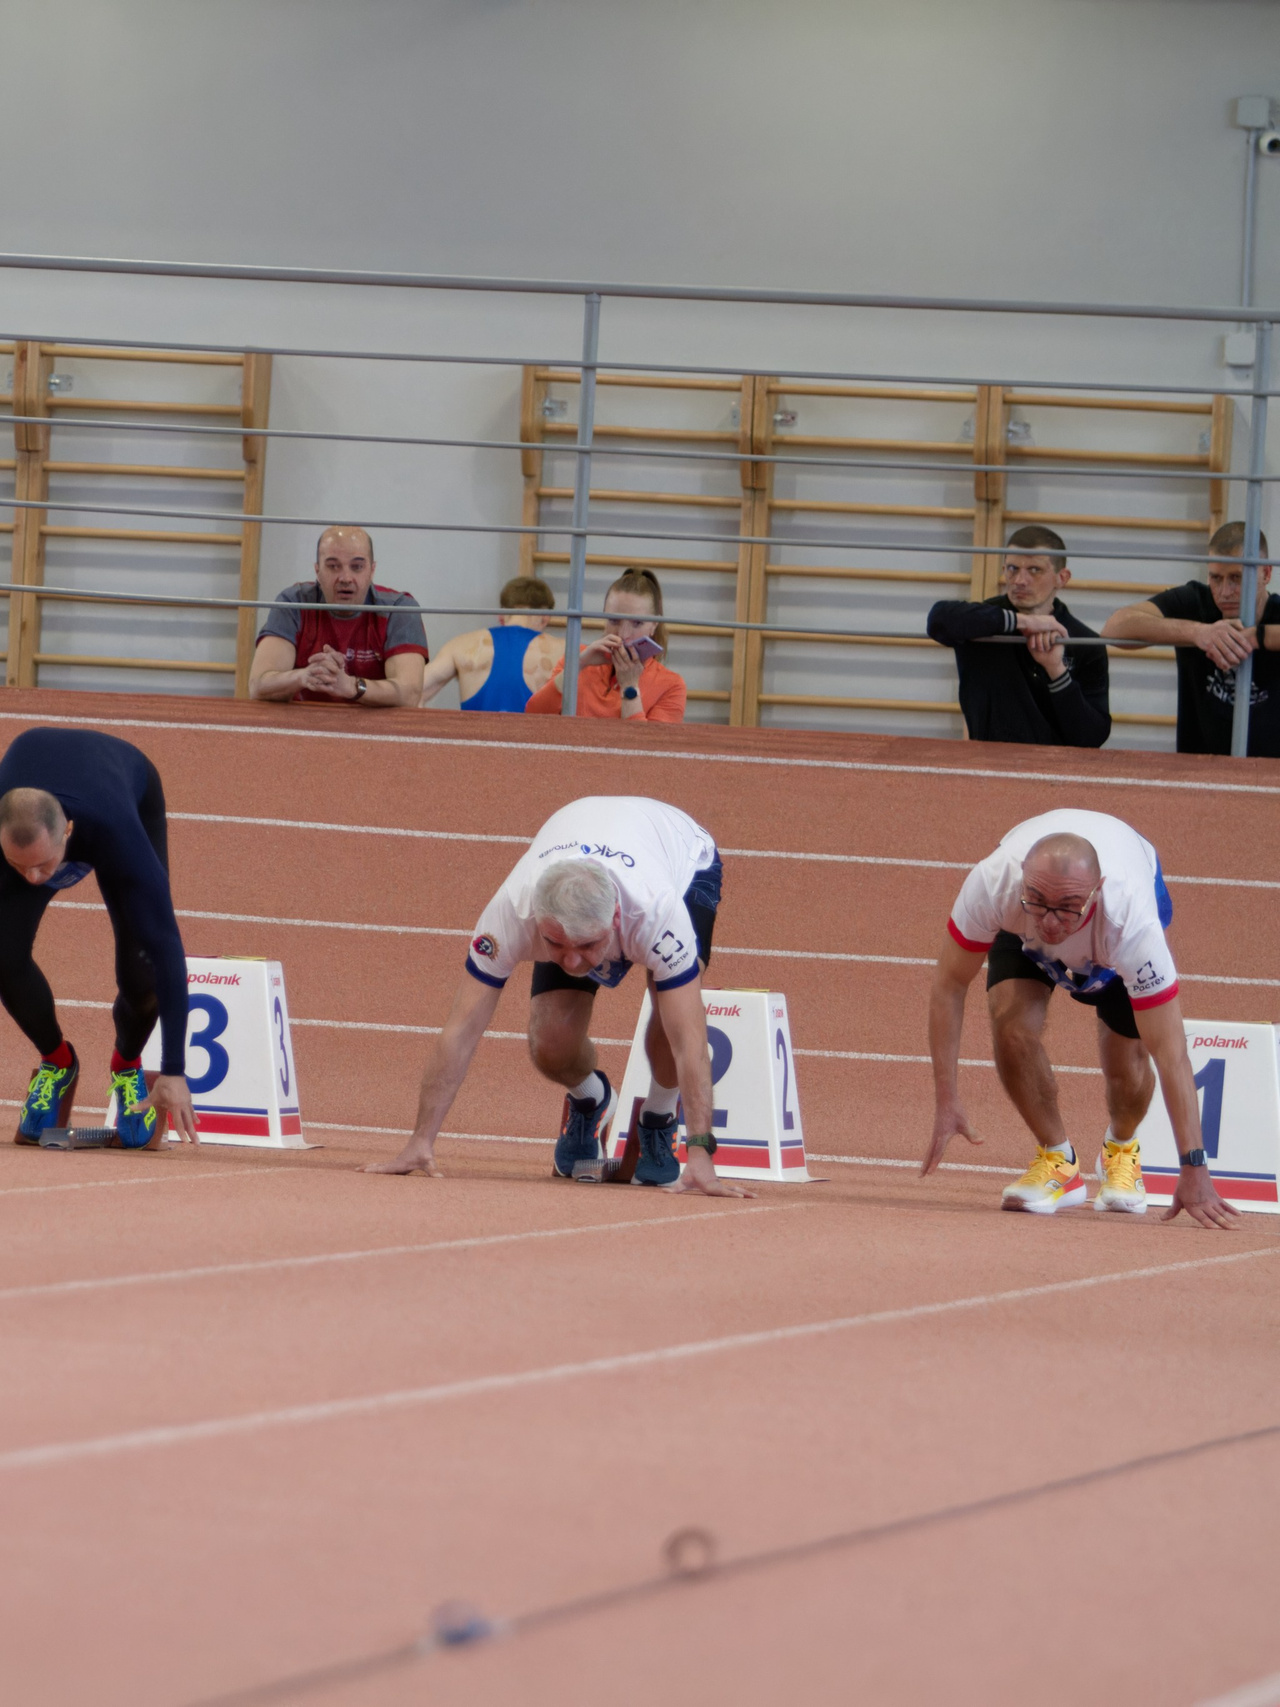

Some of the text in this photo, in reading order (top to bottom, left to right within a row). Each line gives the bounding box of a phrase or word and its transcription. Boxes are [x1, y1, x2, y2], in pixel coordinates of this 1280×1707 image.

[184, 993, 230, 1094] 3
[274, 996, 290, 1097] 3
[705, 1002, 742, 1017] lanik
[776, 1028, 795, 1130] 2
[1193, 1058, 1226, 1159] 1
